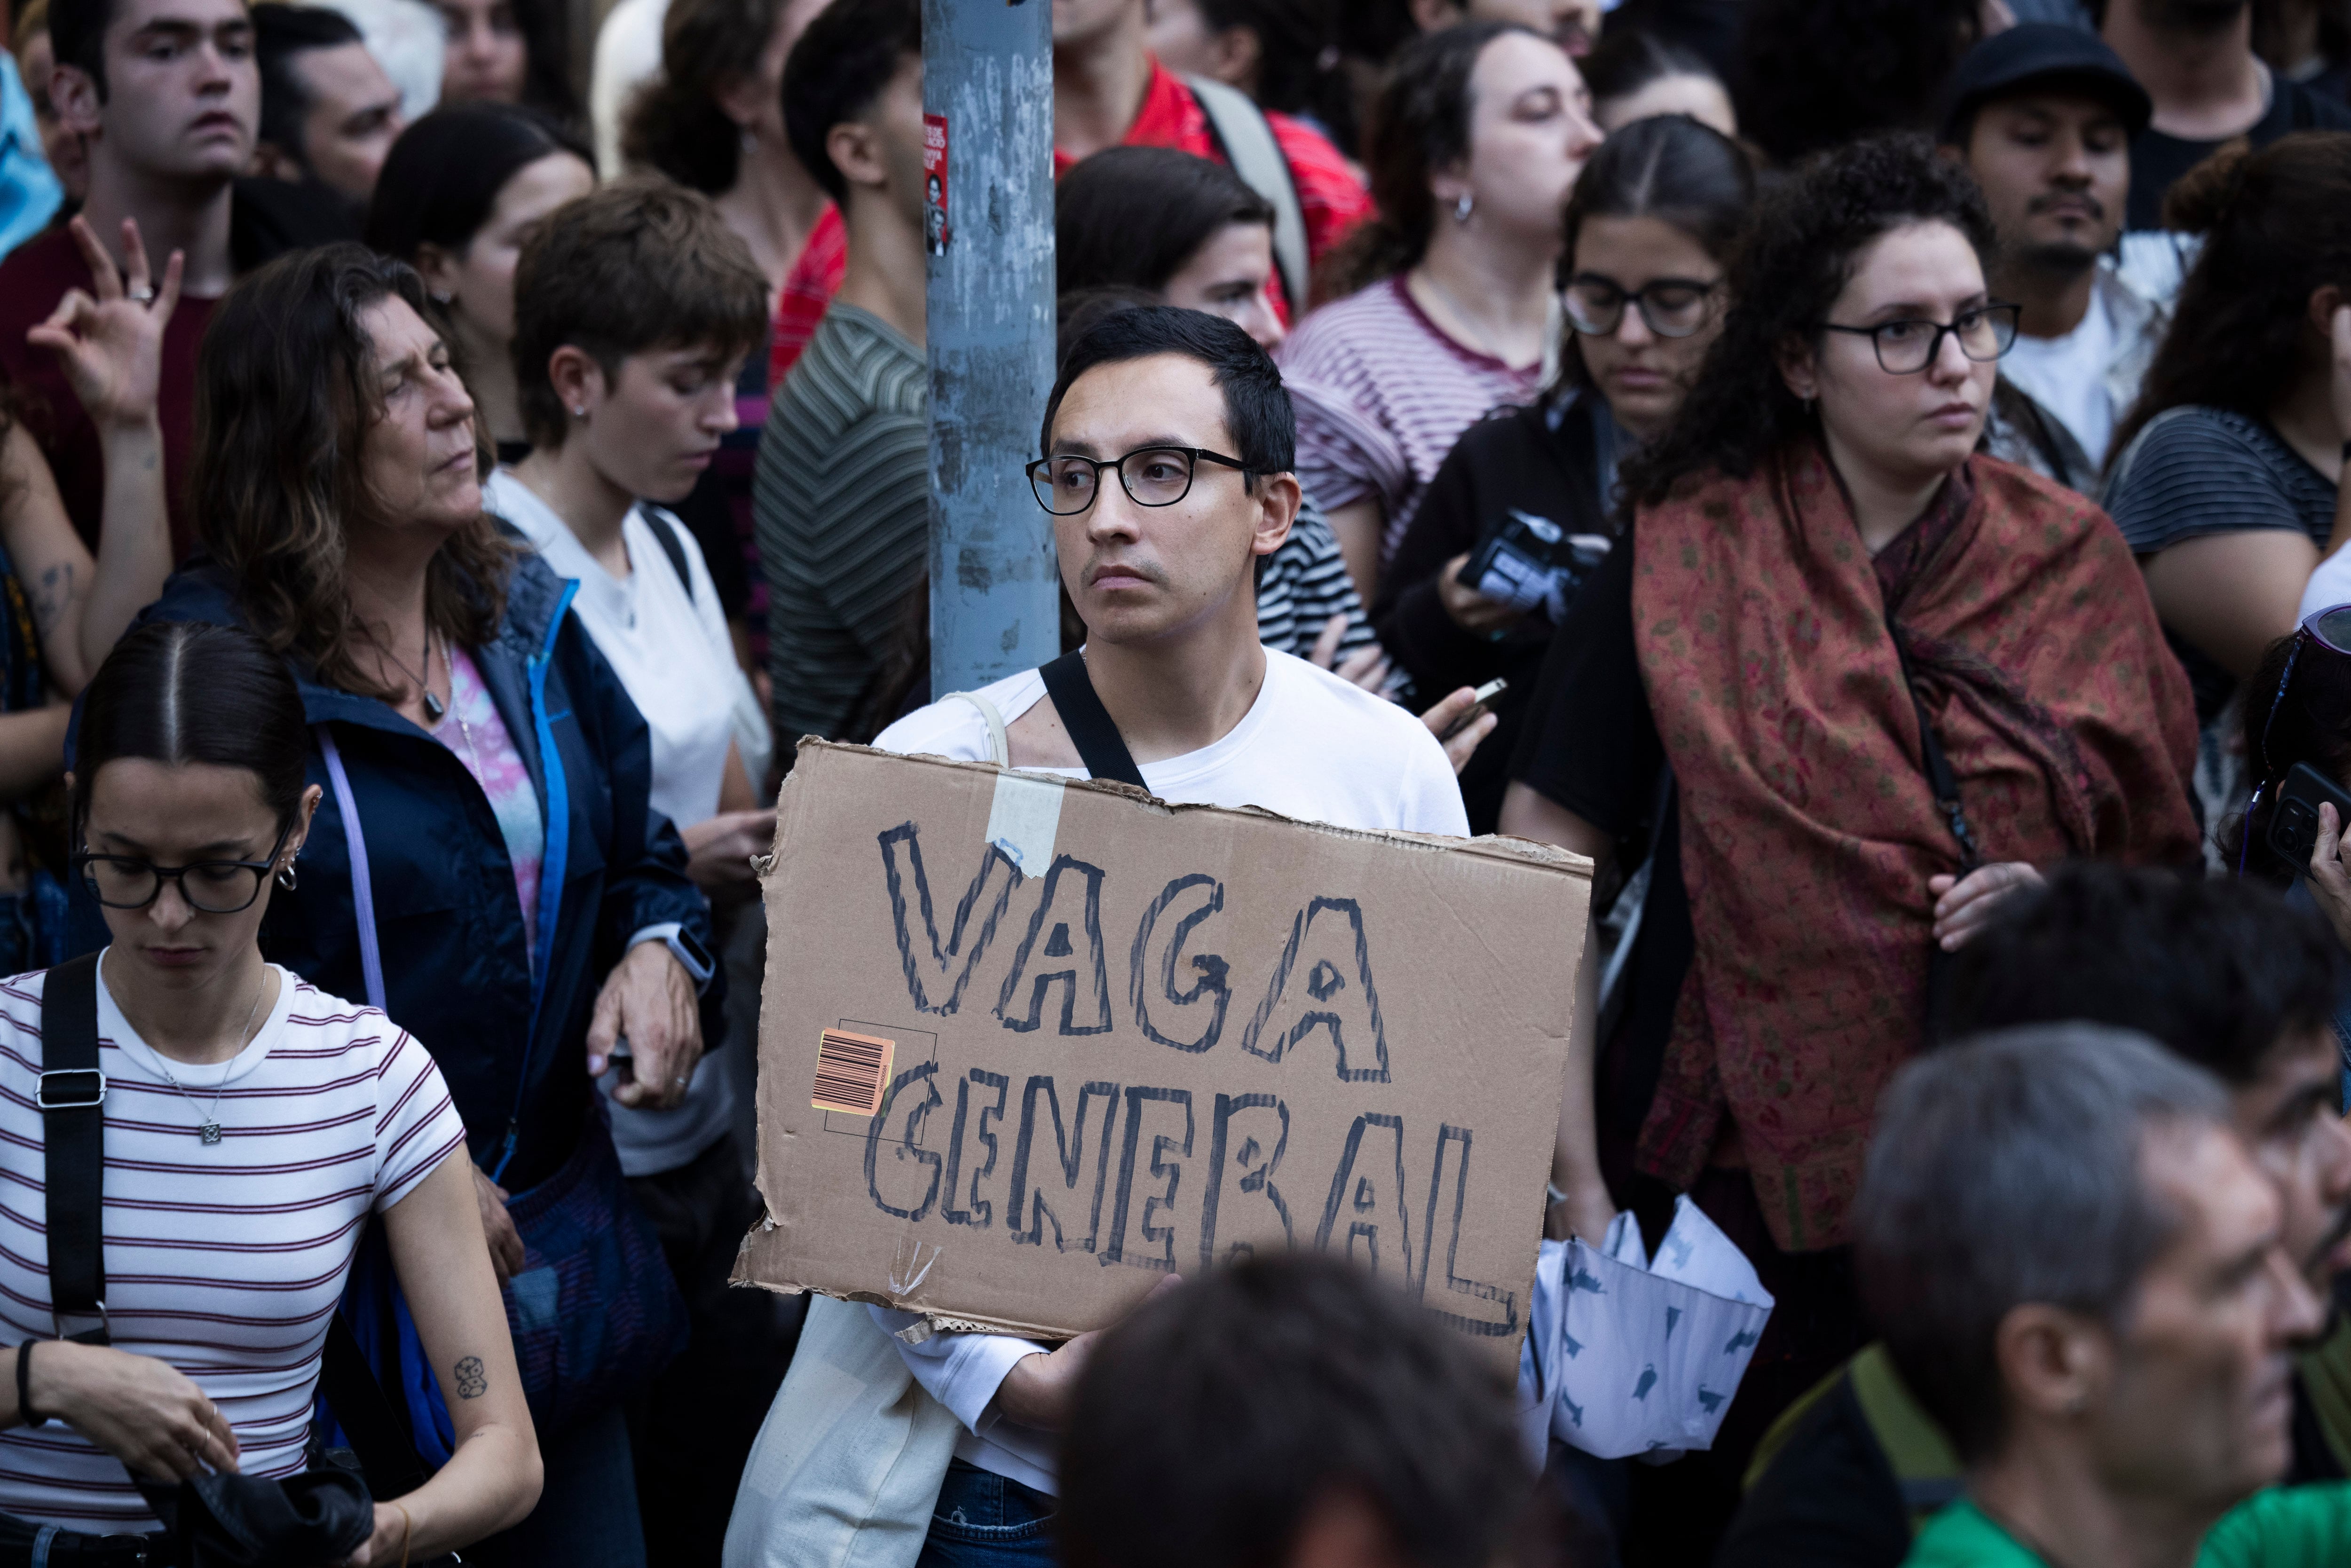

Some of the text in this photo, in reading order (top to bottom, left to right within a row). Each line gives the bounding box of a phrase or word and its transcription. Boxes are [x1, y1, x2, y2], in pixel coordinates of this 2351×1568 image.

[877, 821, 1390, 1083] VAGA
[878, 1064, 887, 1093] 0243400584
[865, 1061, 1518, 1336] GENERAL
